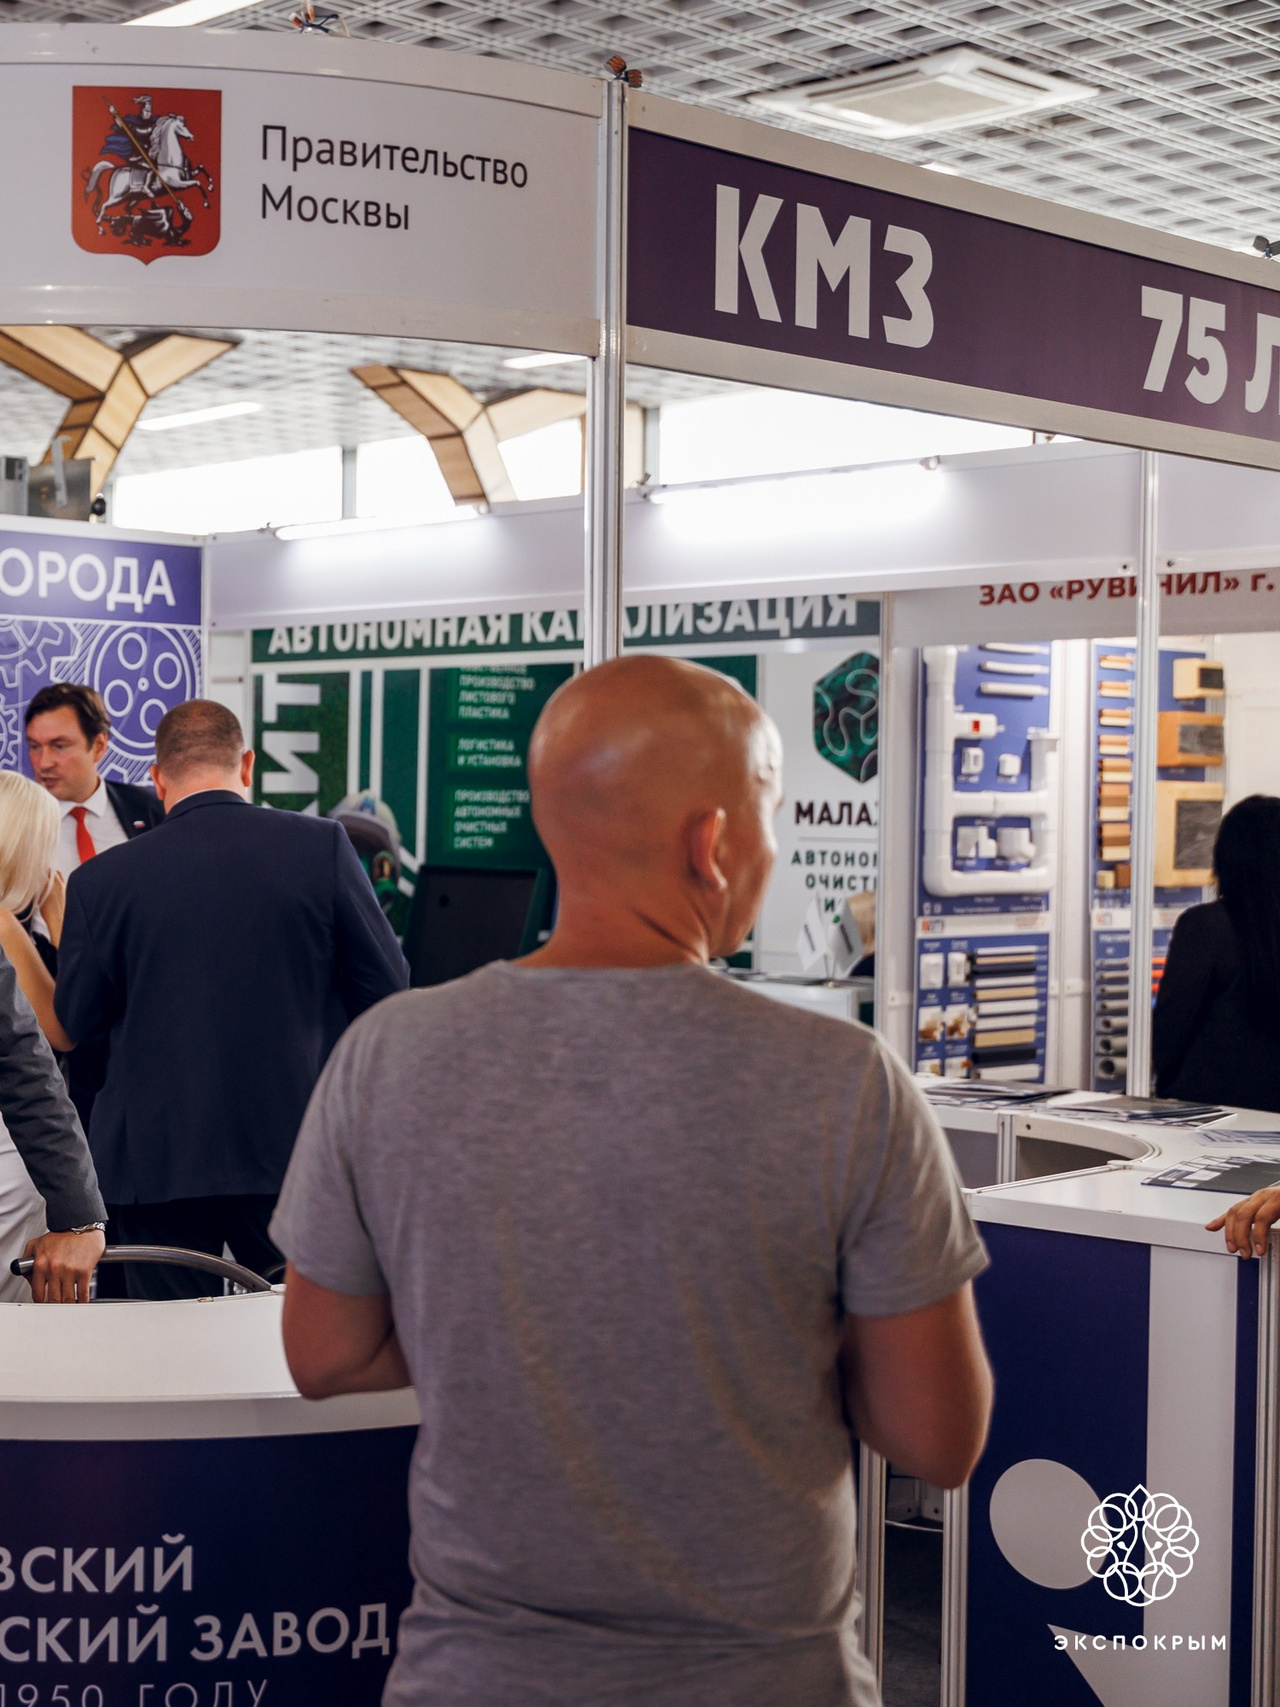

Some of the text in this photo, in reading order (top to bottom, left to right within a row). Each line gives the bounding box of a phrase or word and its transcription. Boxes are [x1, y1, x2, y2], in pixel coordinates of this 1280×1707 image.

[261, 124, 529, 188] Правительство
[261, 183, 410, 230] Москвы
[715, 183, 935, 349] КМЗ
[1141, 285, 1228, 404] 75
[979, 581, 1040, 606] ЗАО
[268, 594, 858, 655] АВТОНОМНАЯ КАЛИЗАЦИЯ
[458, 674, 535, 690] ПРОИЗВОДСТВО
[458, 691, 517, 705] ЛИСТОВОГО
[458, 706, 510, 719] ПЛАСТИКА
[457, 738, 515, 751] ЛОГИСТИКА
[457, 755, 522, 767] И УСТАНОВКА
[454, 789, 530, 803] ПРОИЗВОДСТВО
[795, 801, 878, 826] МАЛА
[454, 821, 508, 835] ОЧИСТНЫХ
[453, 836, 494, 849] СИСТЕМ
[805, 874, 878, 891] ОЧИСТ
[190, 1602, 390, 1661] ЗАВОД
